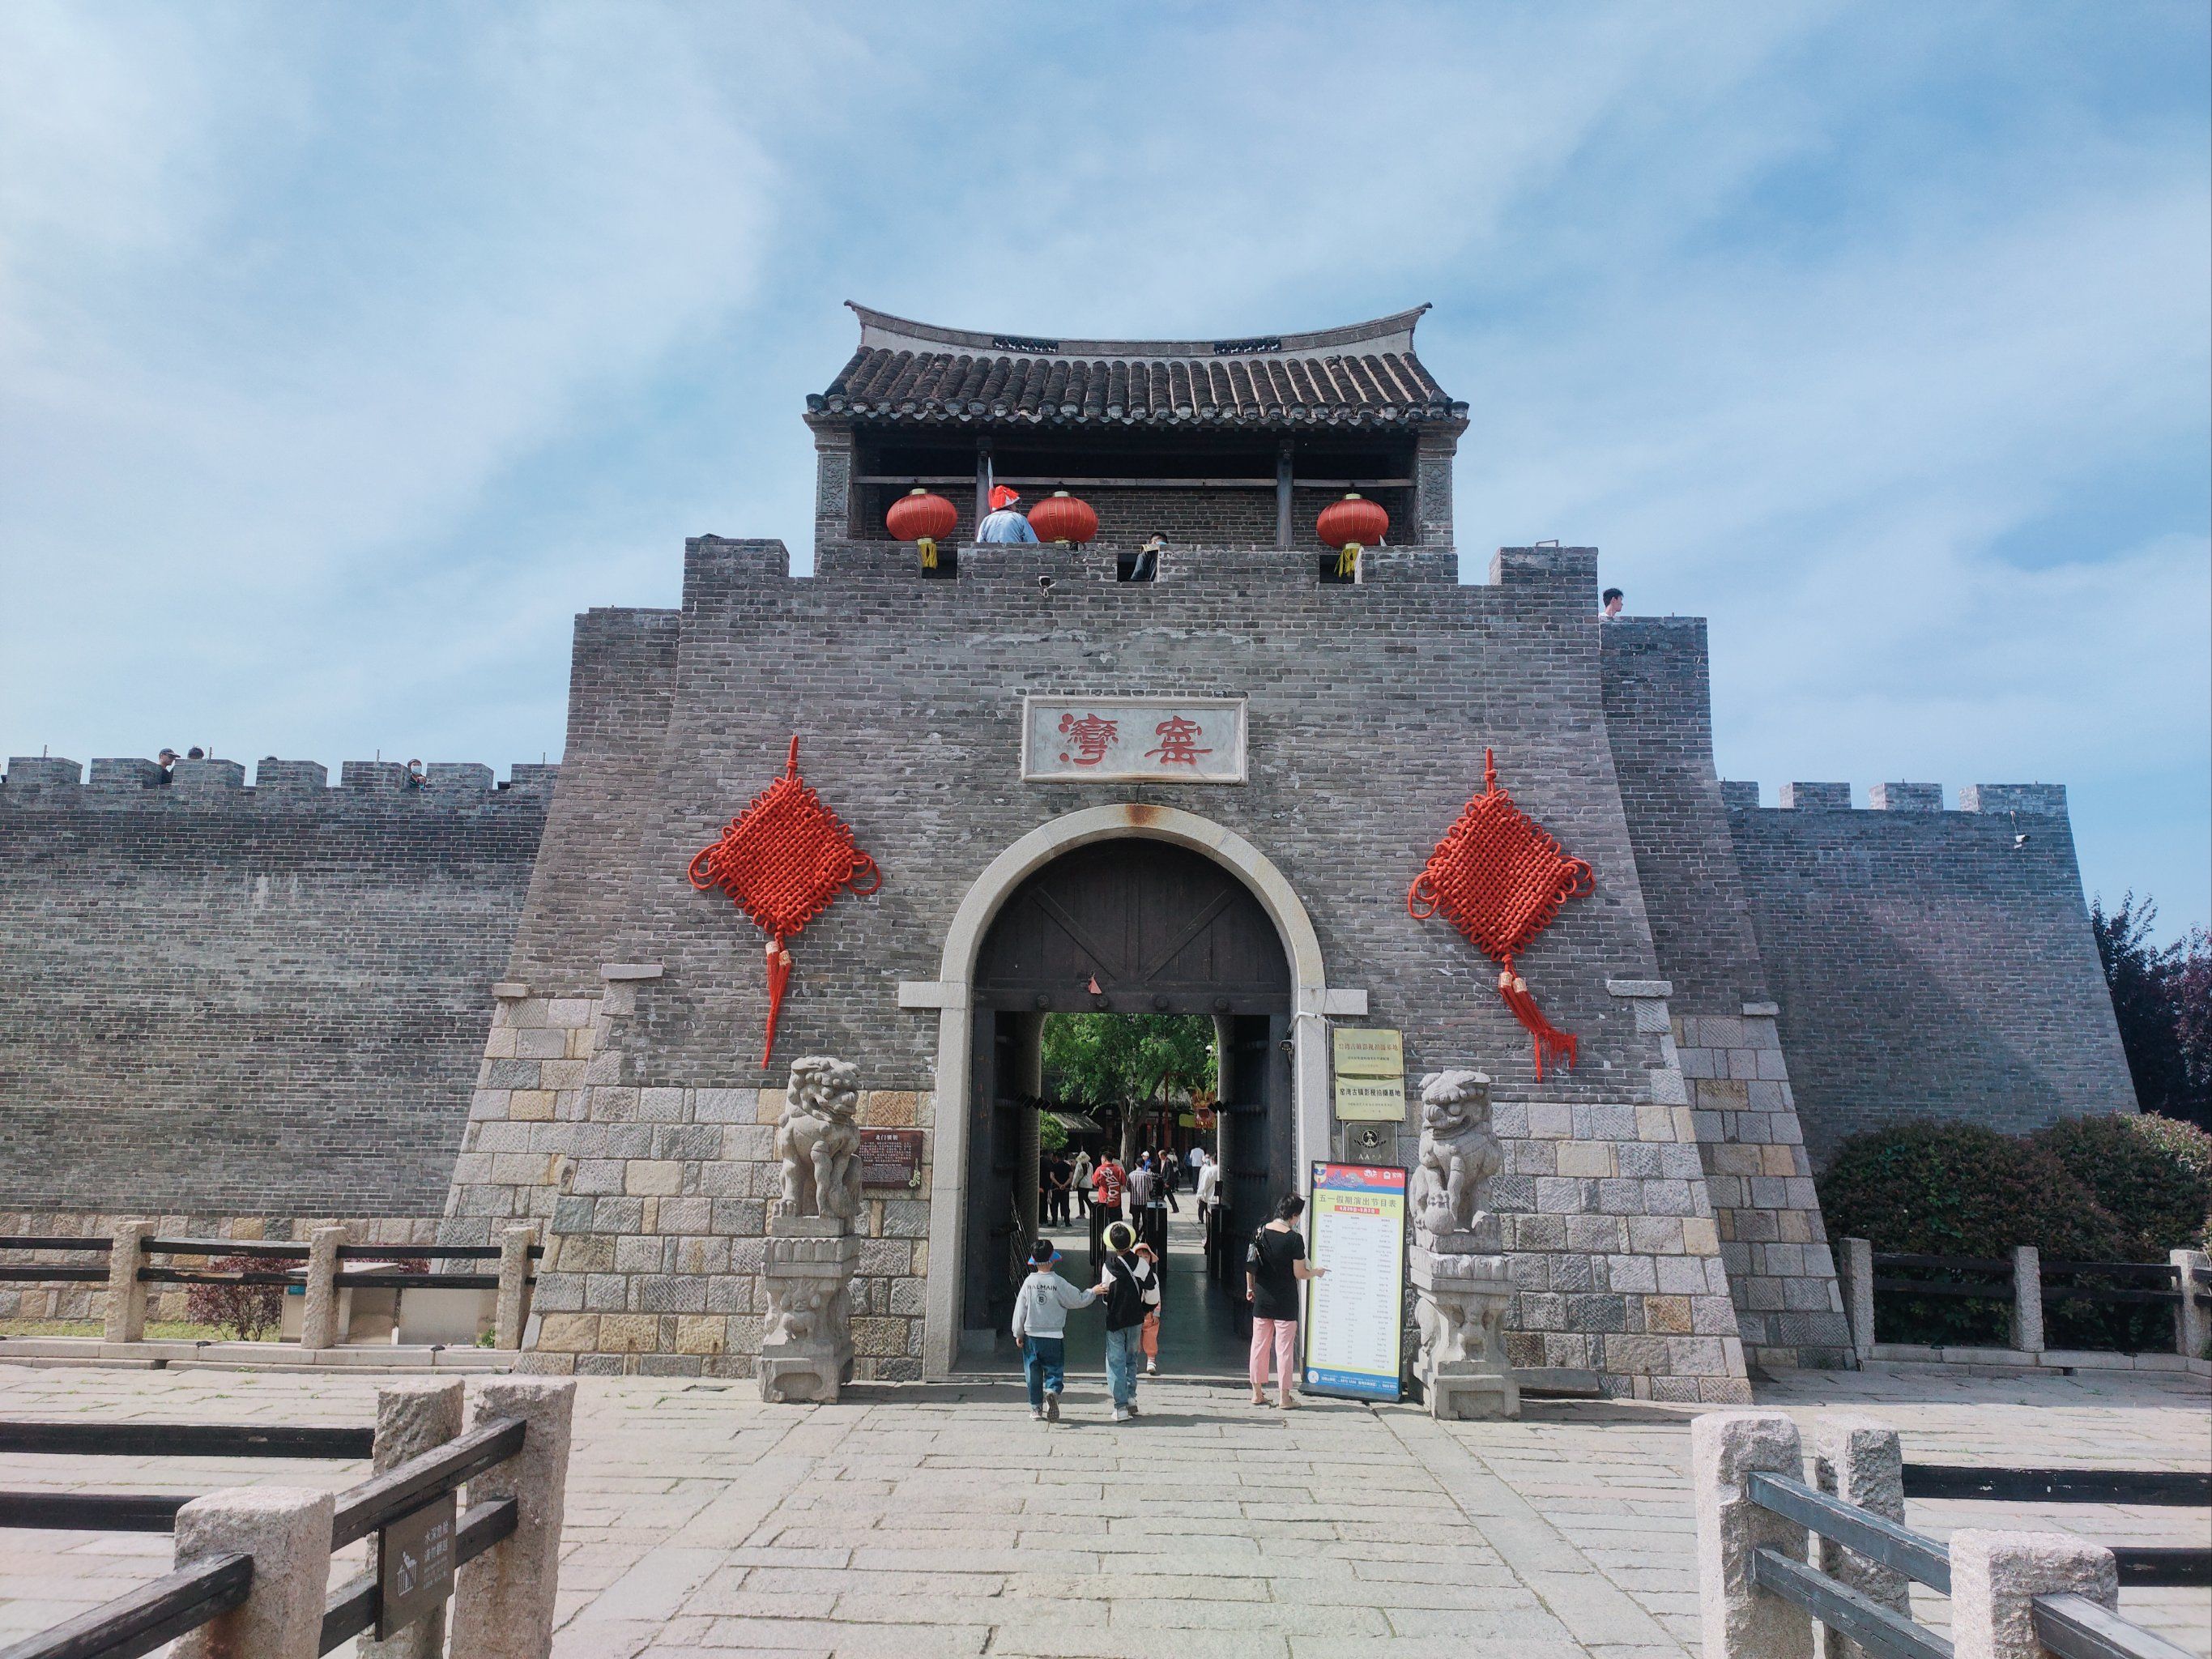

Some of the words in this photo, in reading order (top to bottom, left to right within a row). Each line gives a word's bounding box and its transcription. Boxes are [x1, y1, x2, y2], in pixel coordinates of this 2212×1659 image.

[1319, 1194, 1397, 1208] 五一假期演出节目表
